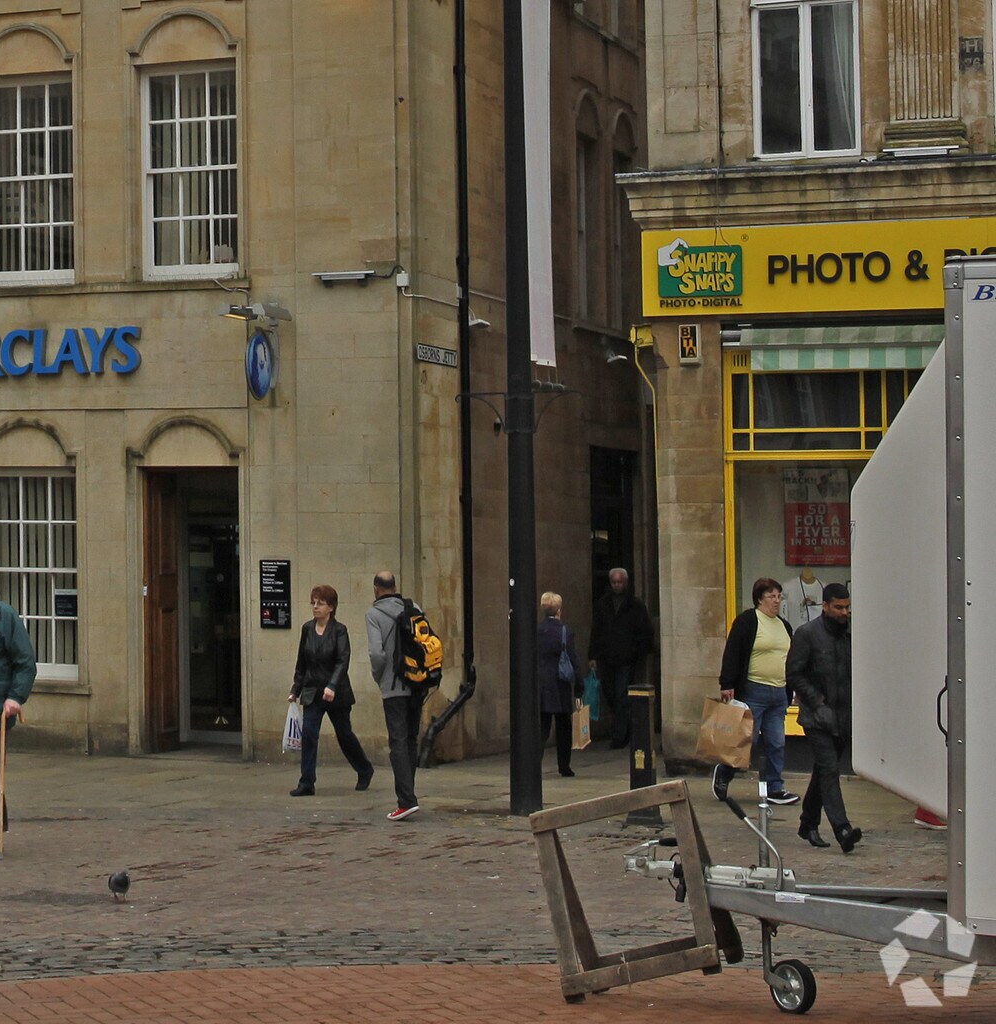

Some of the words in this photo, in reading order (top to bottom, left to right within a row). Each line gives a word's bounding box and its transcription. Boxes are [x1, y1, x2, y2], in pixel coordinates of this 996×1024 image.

[668, 250, 737, 277] SNAPPY
[768, 250, 891, 284] PHOTO
[904, 249, 930, 281] &
[679, 273, 734, 294] SNAPS
[972, 284, 996, 301] B
[702, 297, 743, 307] DIGITAL
[808, 504, 825, 514] 50
[795, 516, 824, 526] FOR
[830, 516, 840, 526] A
[795, 527, 840, 536] FIVER
